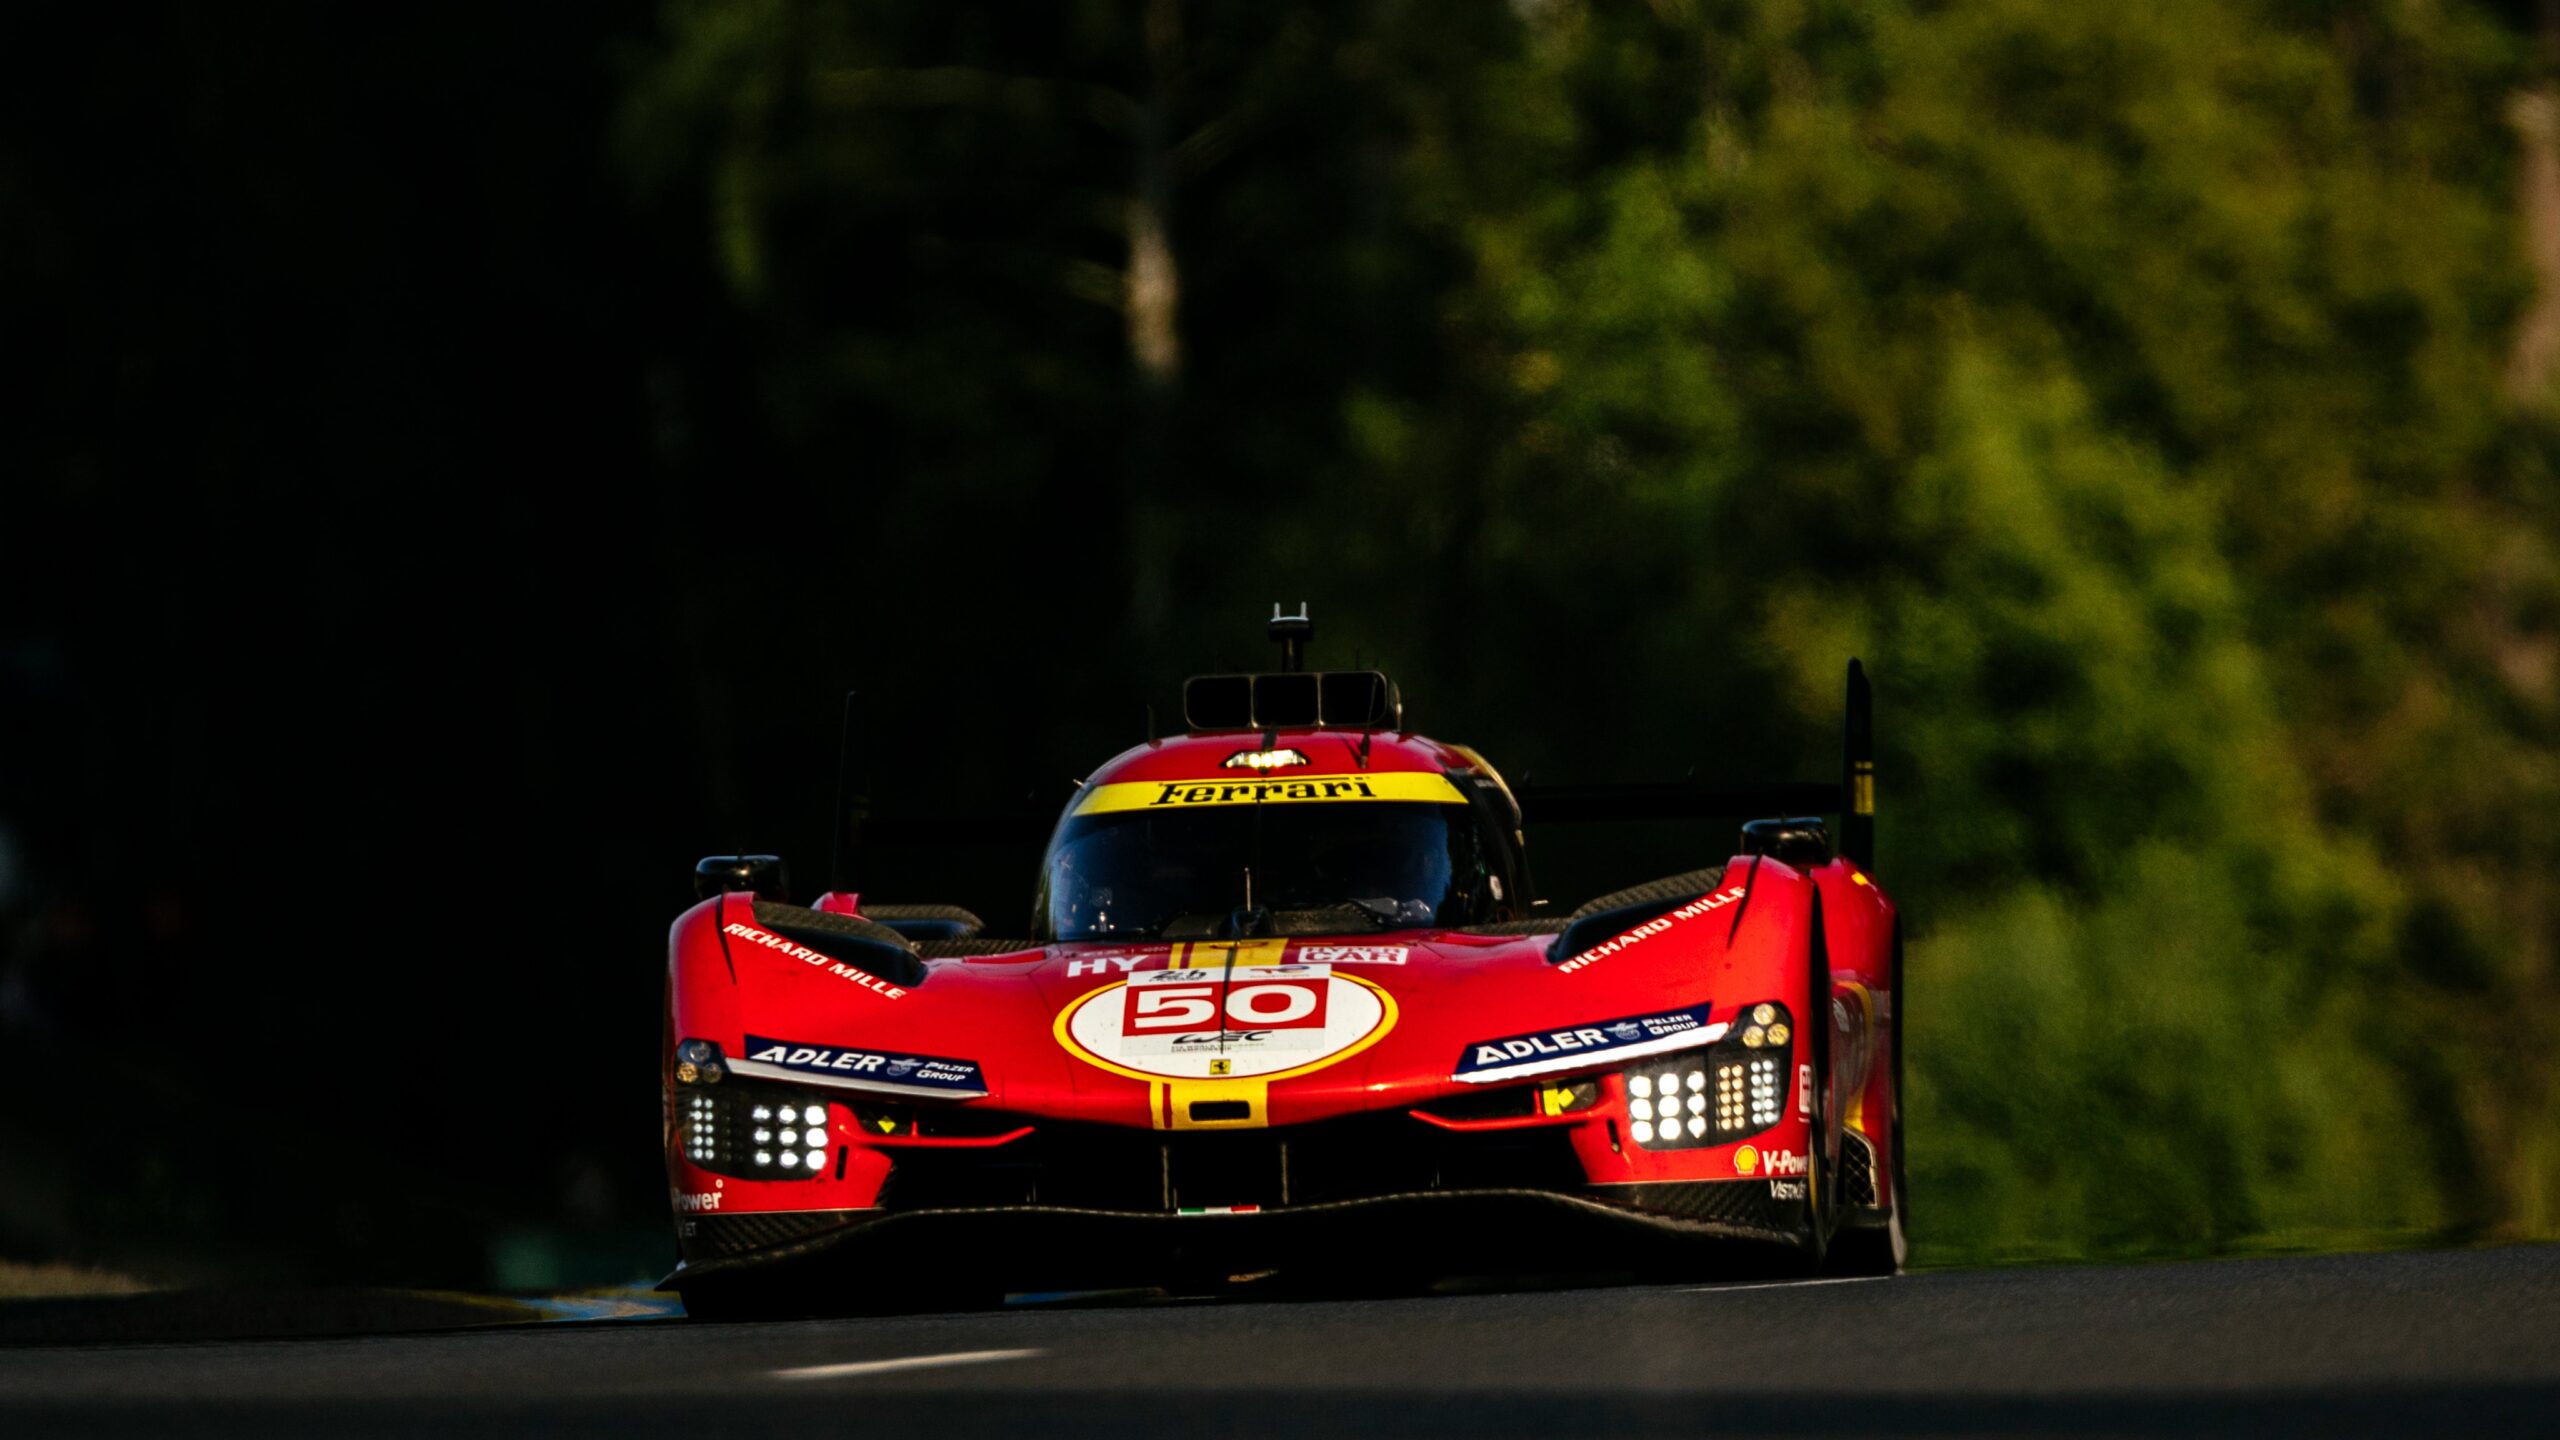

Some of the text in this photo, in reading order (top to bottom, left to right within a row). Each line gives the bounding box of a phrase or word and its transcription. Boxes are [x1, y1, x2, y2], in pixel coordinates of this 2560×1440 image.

[1150, 776, 1376, 806] Ferrari
[1558, 886, 1746, 974] RICHARD MILLE
[723, 923, 907, 1000] RICHARD MILLE
[1067, 955, 1149, 978] HY
[1134, 984, 1317, 1029] 50
[1642, 1014, 1693, 1028] PELZER
[1649, 1021, 1699, 1036] GROUP
[750, 1046, 886, 1072] ADLER
[1476, 1029, 1609, 1066] ADLER
[917, 1069, 966, 1082] GROUP
[925, 1061, 974, 1074] PELZER
